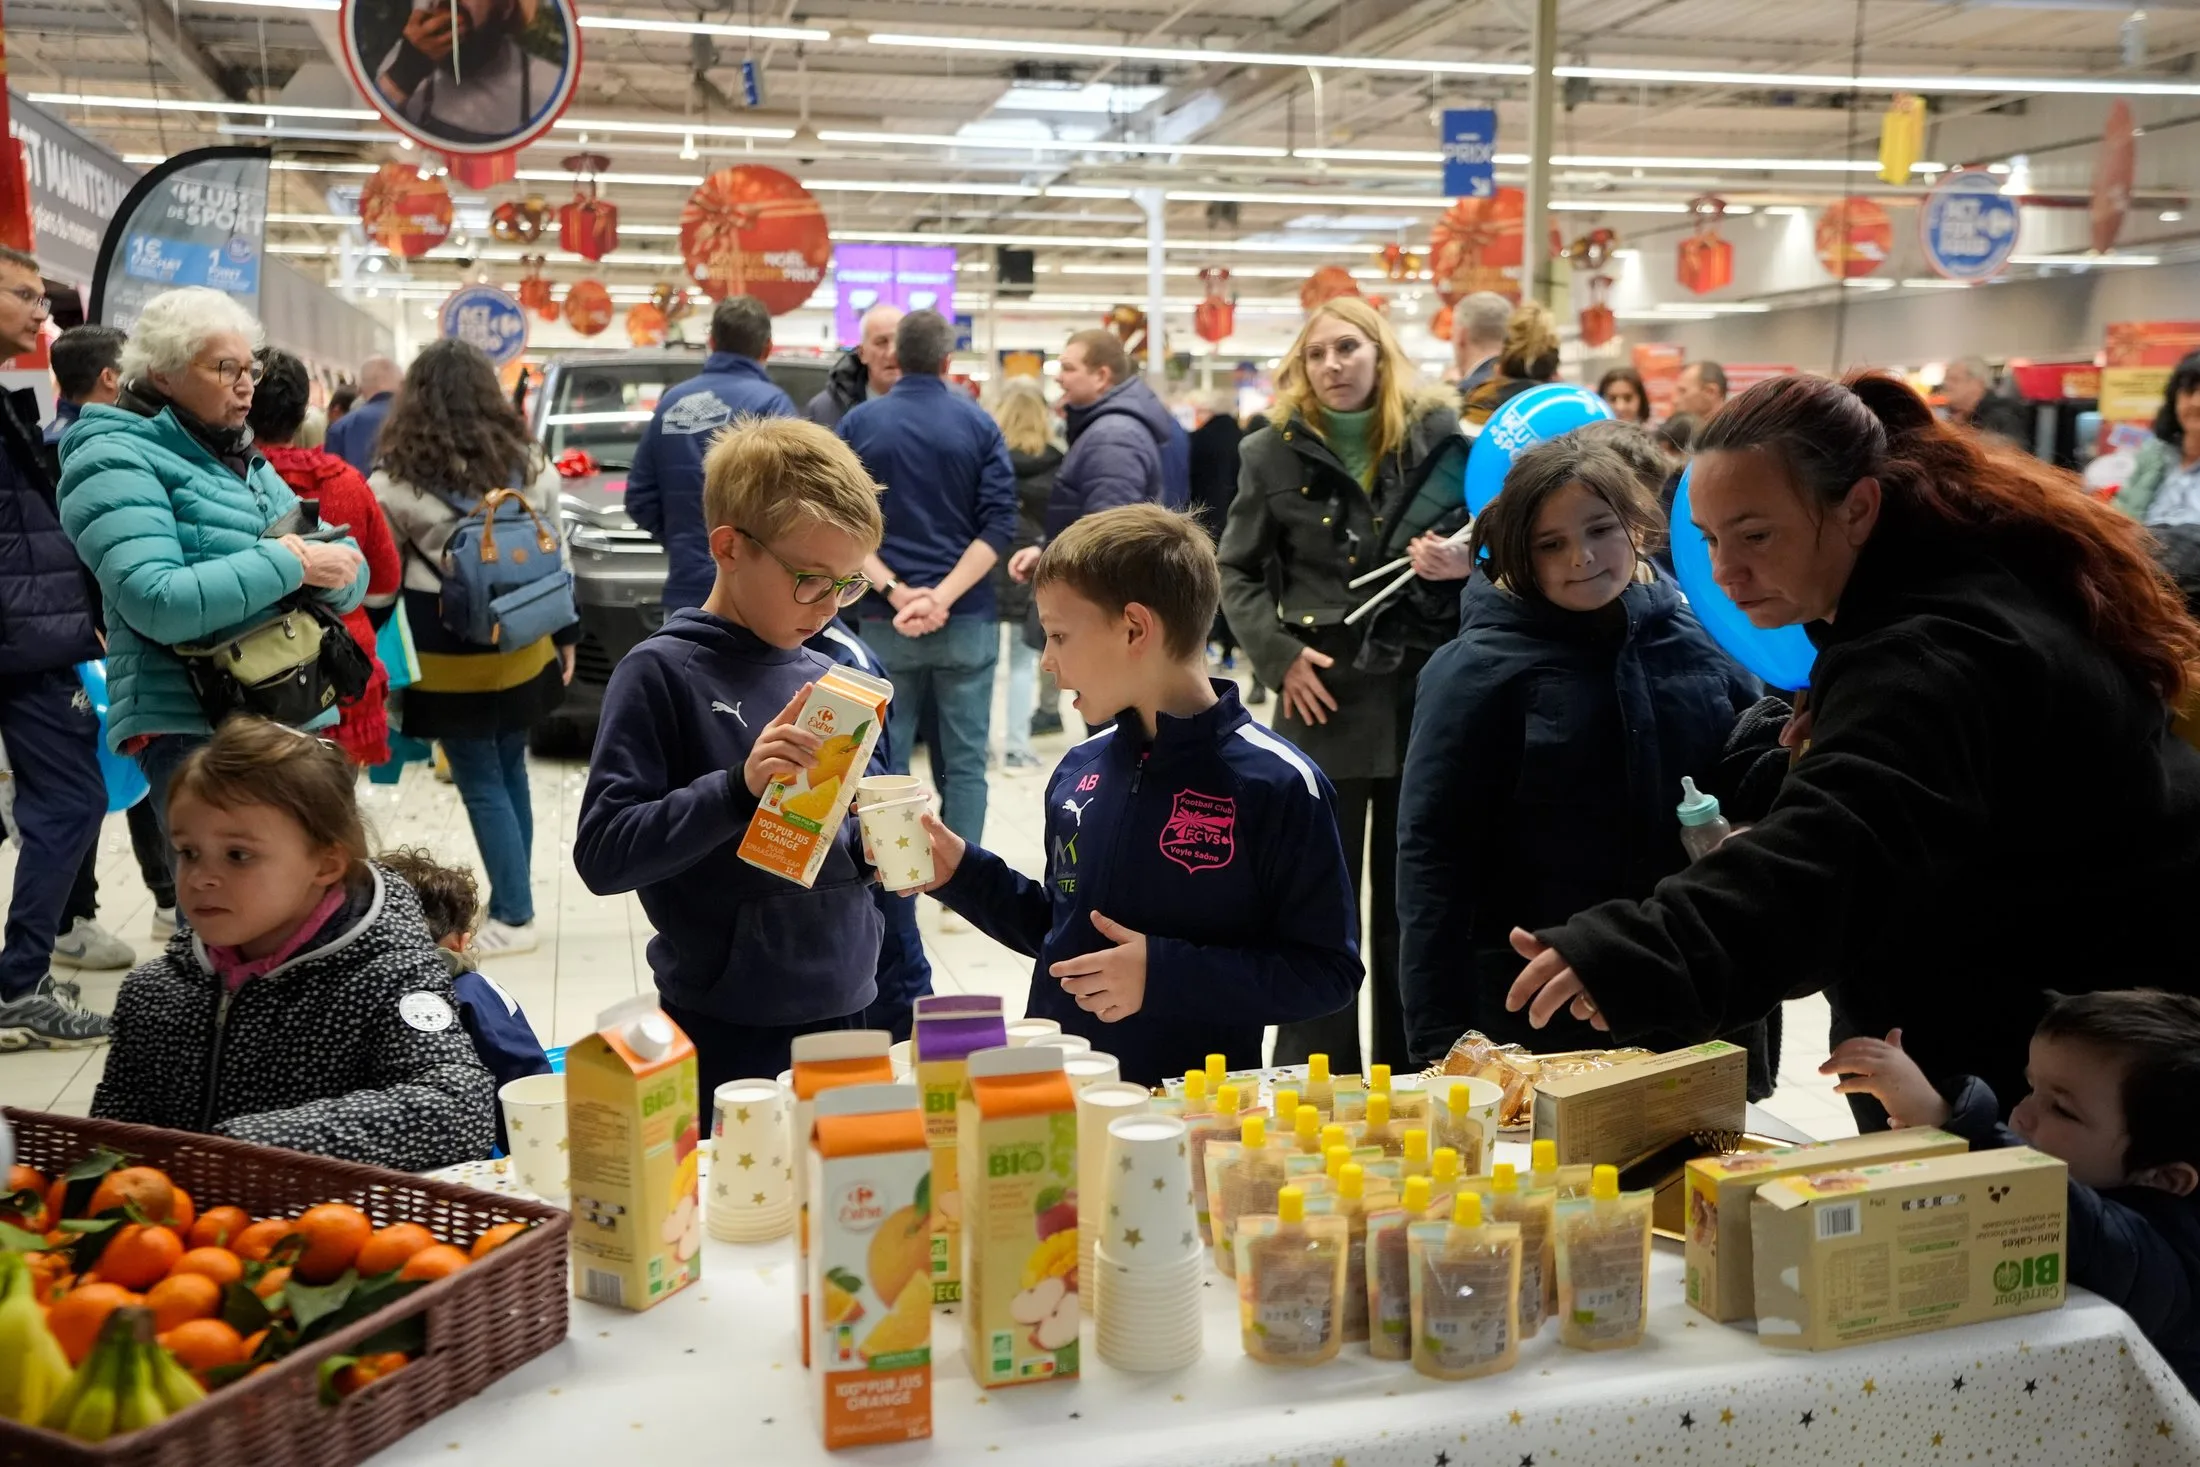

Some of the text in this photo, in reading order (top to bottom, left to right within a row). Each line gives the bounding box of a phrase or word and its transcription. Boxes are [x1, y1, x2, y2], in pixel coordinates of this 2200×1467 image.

[185, 204, 264, 236] SPORT
[808, 716, 835, 734] Extra
[1075, 774, 1100, 793] AB
[1180, 797, 1233, 815] Football Club
[760, 829, 800, 851] ORANGE
[776, 825, 794, 838] PUR
[794, 833, 811, 845] JUS
[1185, 827, 1222, 845] FCVS
[767, 843, 785, 855] PUUR
[1169, 846, 1220, 863] Veyle Saône
[925, 1092, 957, 1113] BI
[989, 1151, 1045, 1178] BIO
[2002, 1232, 2060, 1249] Mini-cakes
[1993, 1252, 2059, 1293] BIO
[1993, 1285, 2059, 1307] Carrefour
